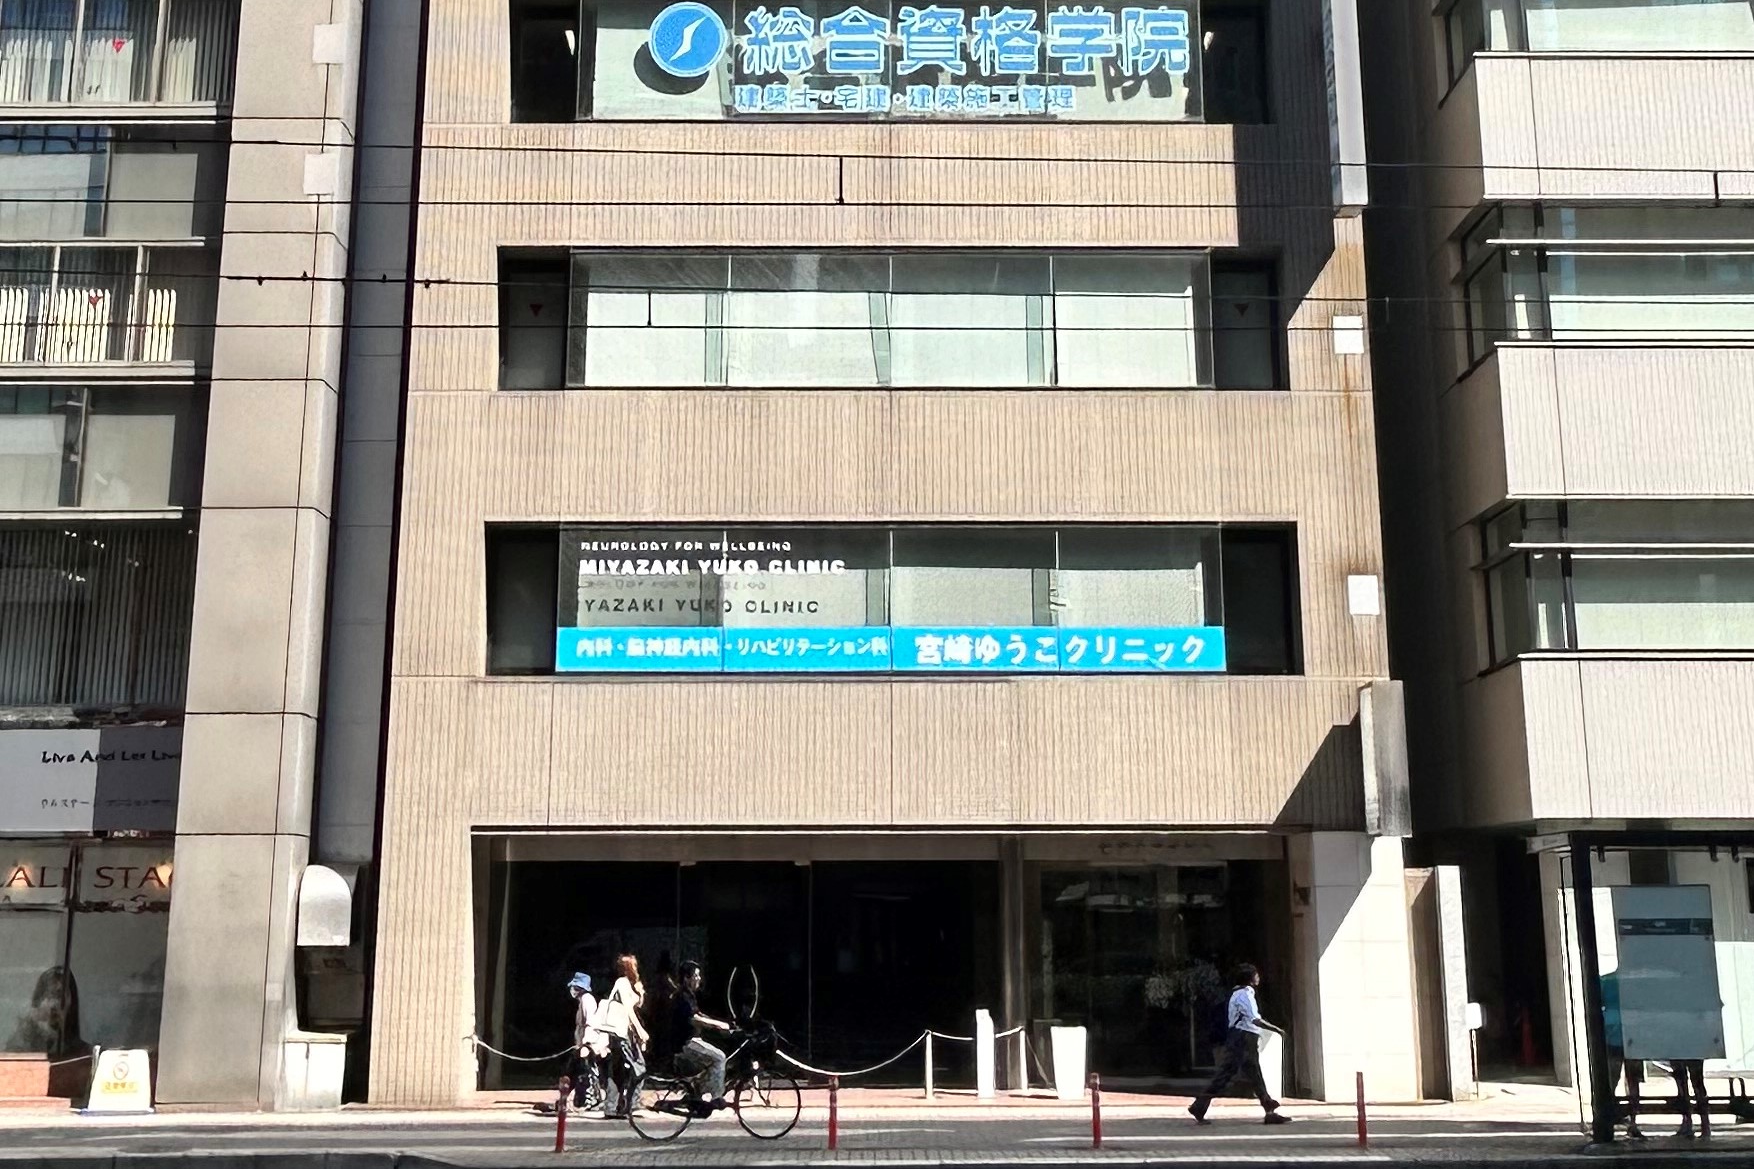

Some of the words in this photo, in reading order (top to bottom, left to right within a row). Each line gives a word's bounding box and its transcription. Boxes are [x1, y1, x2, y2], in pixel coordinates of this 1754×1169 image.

[743, 5, 1191, 76] 総合資格学院
[674, 541, 704, 552] FOR
[578, 559, 690, 576] MIYAZAKI
[697, 559, 760, 576] YUKO
[768, 559, 847, 576] CLINIC
